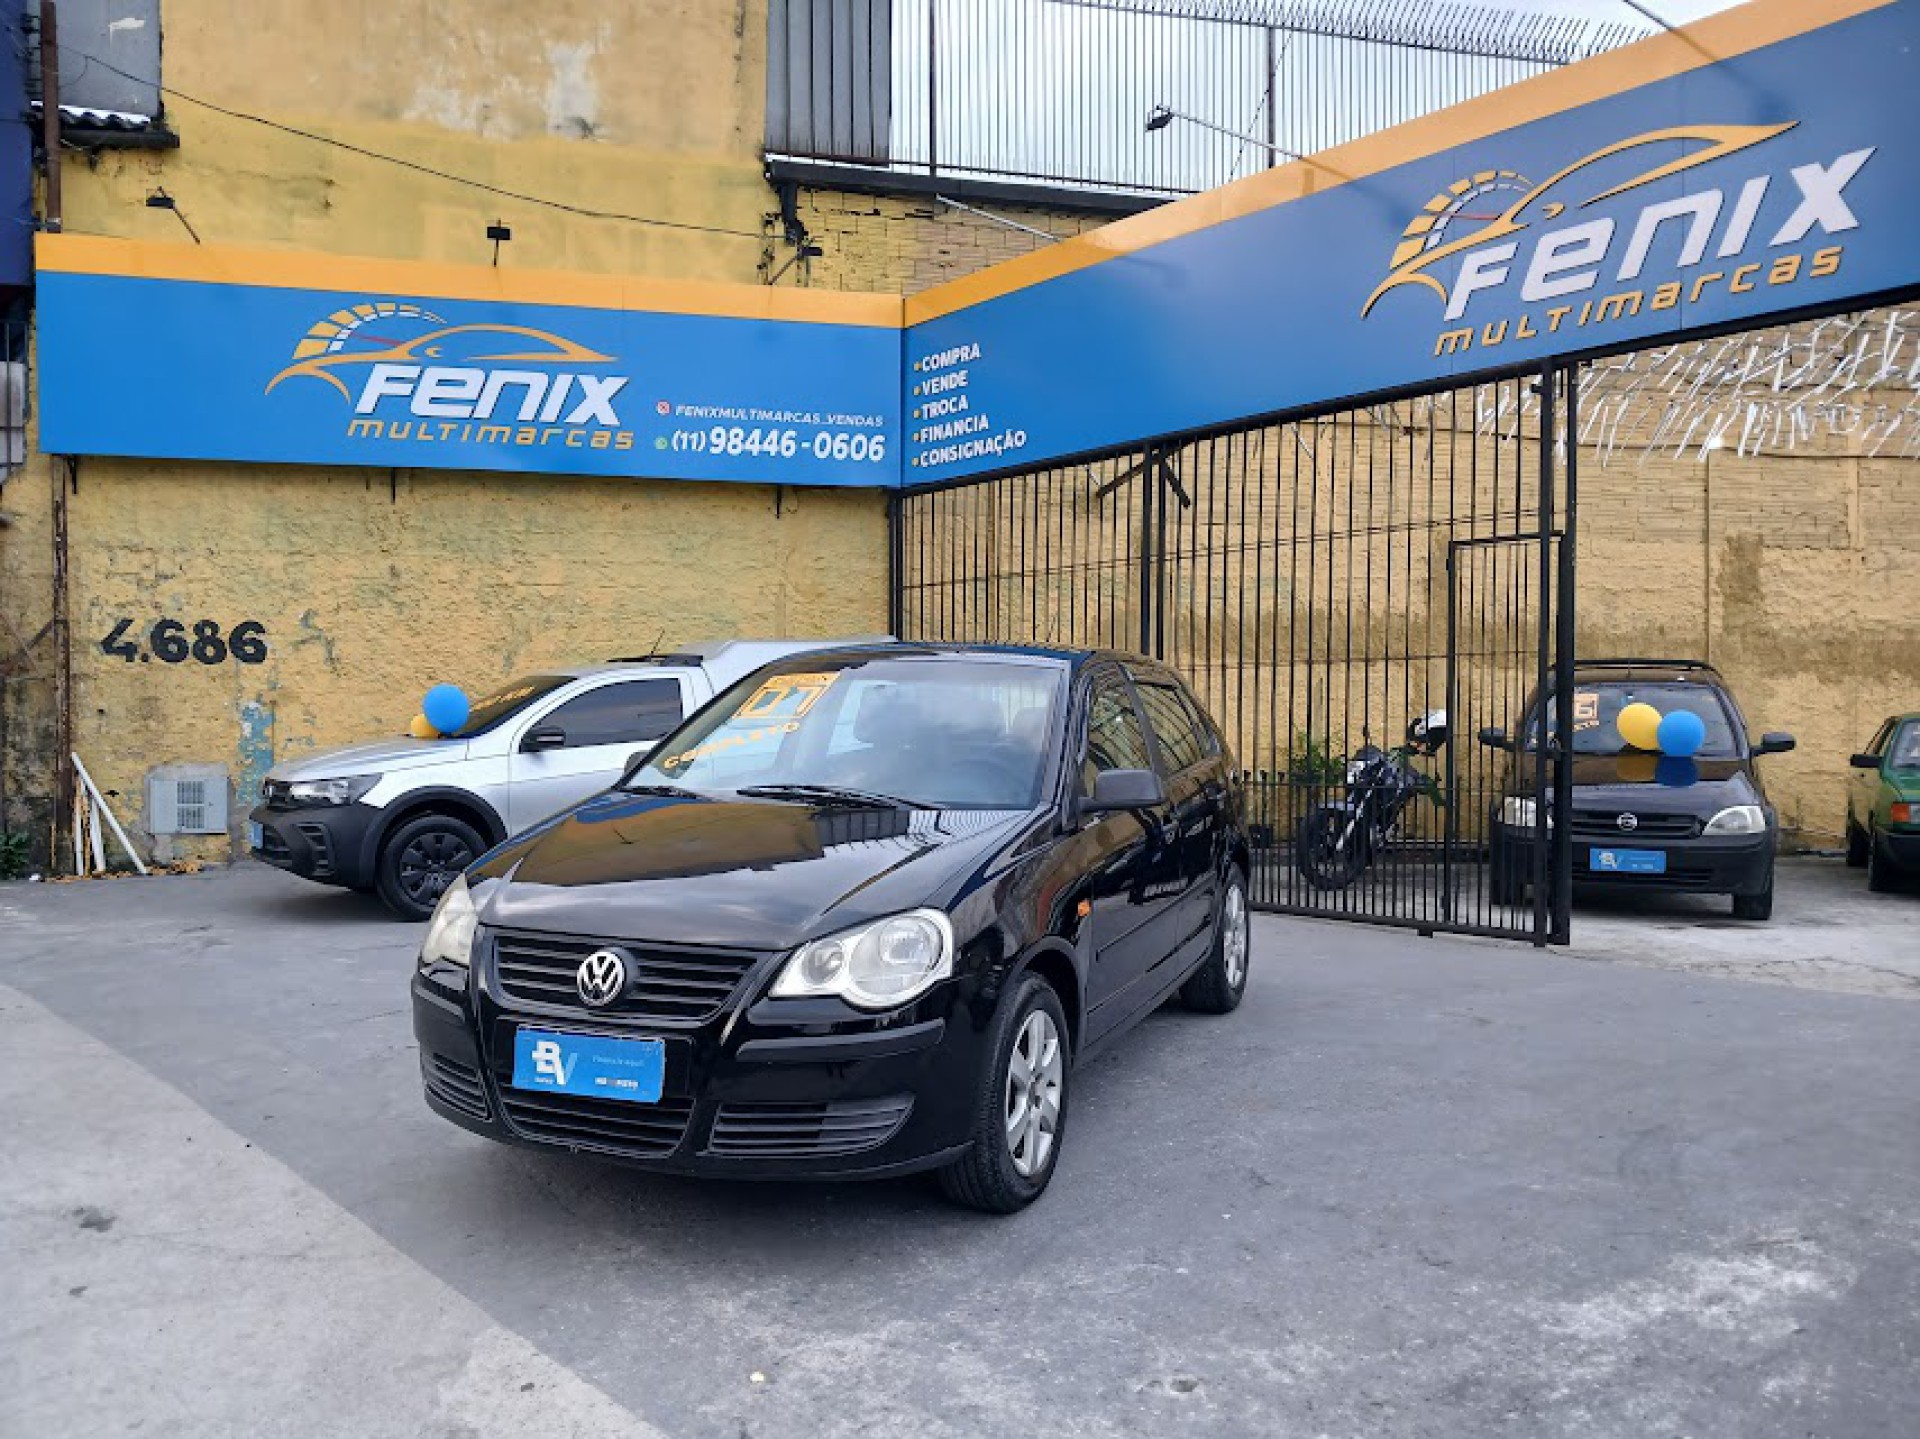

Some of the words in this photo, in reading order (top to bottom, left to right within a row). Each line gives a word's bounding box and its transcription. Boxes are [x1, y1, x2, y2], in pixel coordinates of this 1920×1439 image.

[1444, 146, 1876, 322] FENIX
[1435, 246, 1844, 356] MULTIMARCAS
[922, 343, 982, 372] COMPRA
[355, 363, 630, 426] FENIX
[922, 369, 969, 396] VENDE
[675, 404, 884, 427] FENIXMULTIMARCAS_VENDAS
[921, 394, 969, 420] TROCA
[347, 419, 634, 450] MULTIMARCAS
[671, 429, 706, 452] (11)
[920, 413, 989, 443] FINANCIA
[919, 428, 1027, 468] CONSIGNAÇÃO
[100, 618, 269, 665] 4.686
